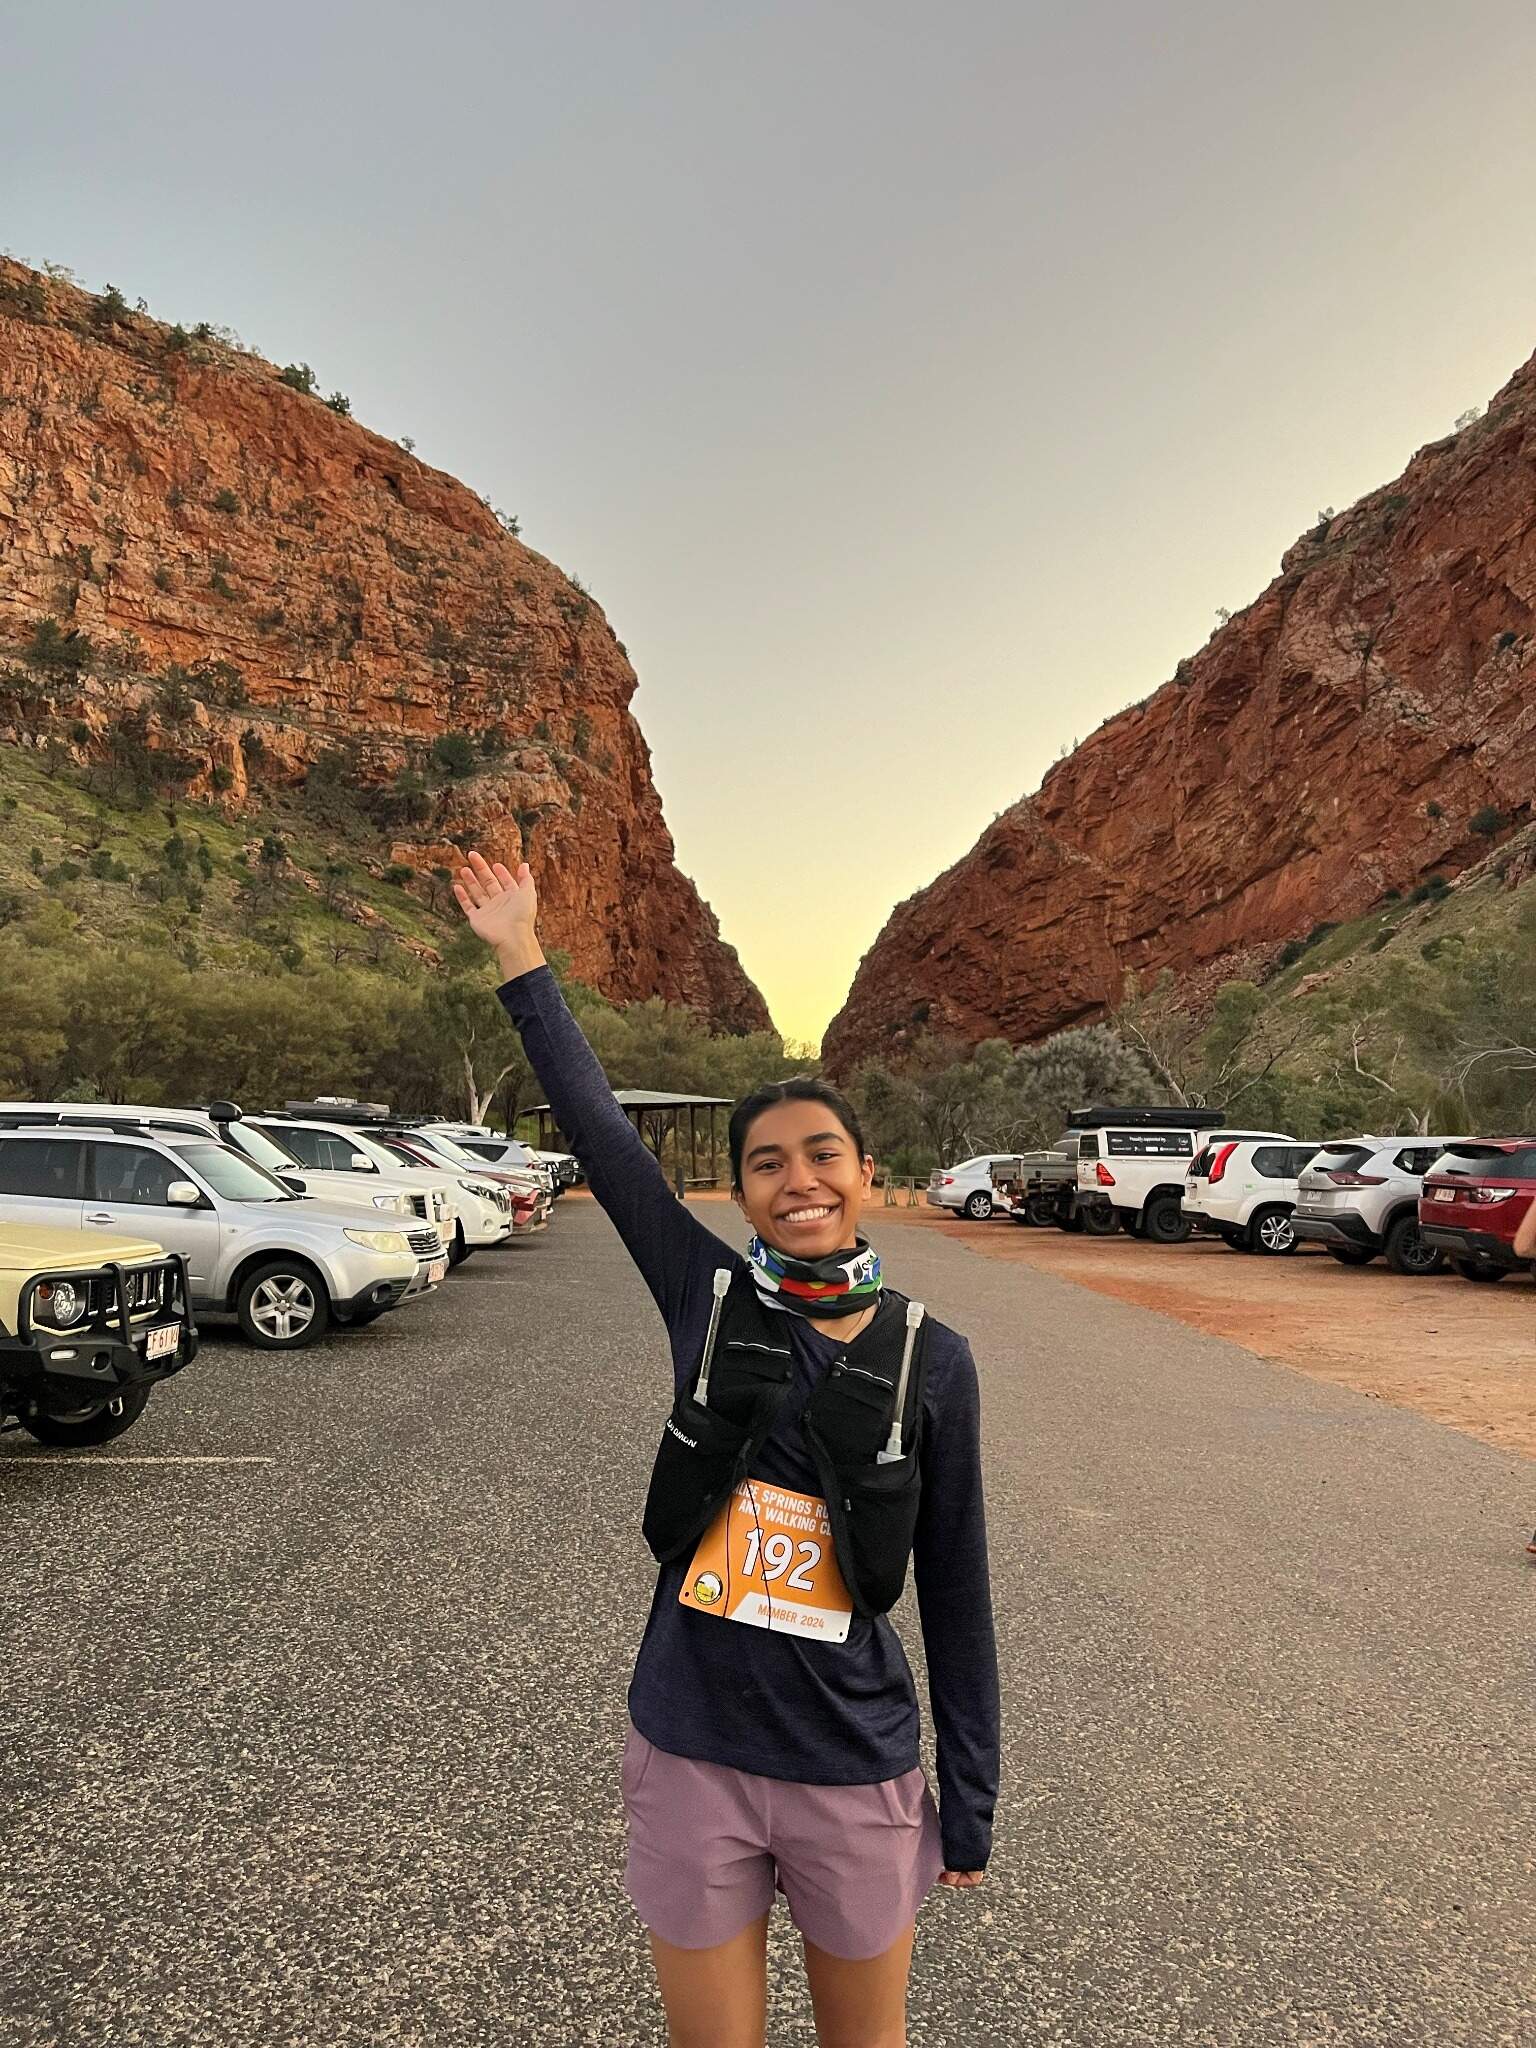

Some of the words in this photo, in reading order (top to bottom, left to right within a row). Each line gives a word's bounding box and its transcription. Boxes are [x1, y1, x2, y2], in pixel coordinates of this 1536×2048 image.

[738, 1498, 761, 1517] AND
[765, 1506, 817, 1533] WALKING
[761, 1489, 812, 1515] SPRINGS
[740, 1526, 822, 1592] 192
[800, 1615, 825, 1629] 2024
